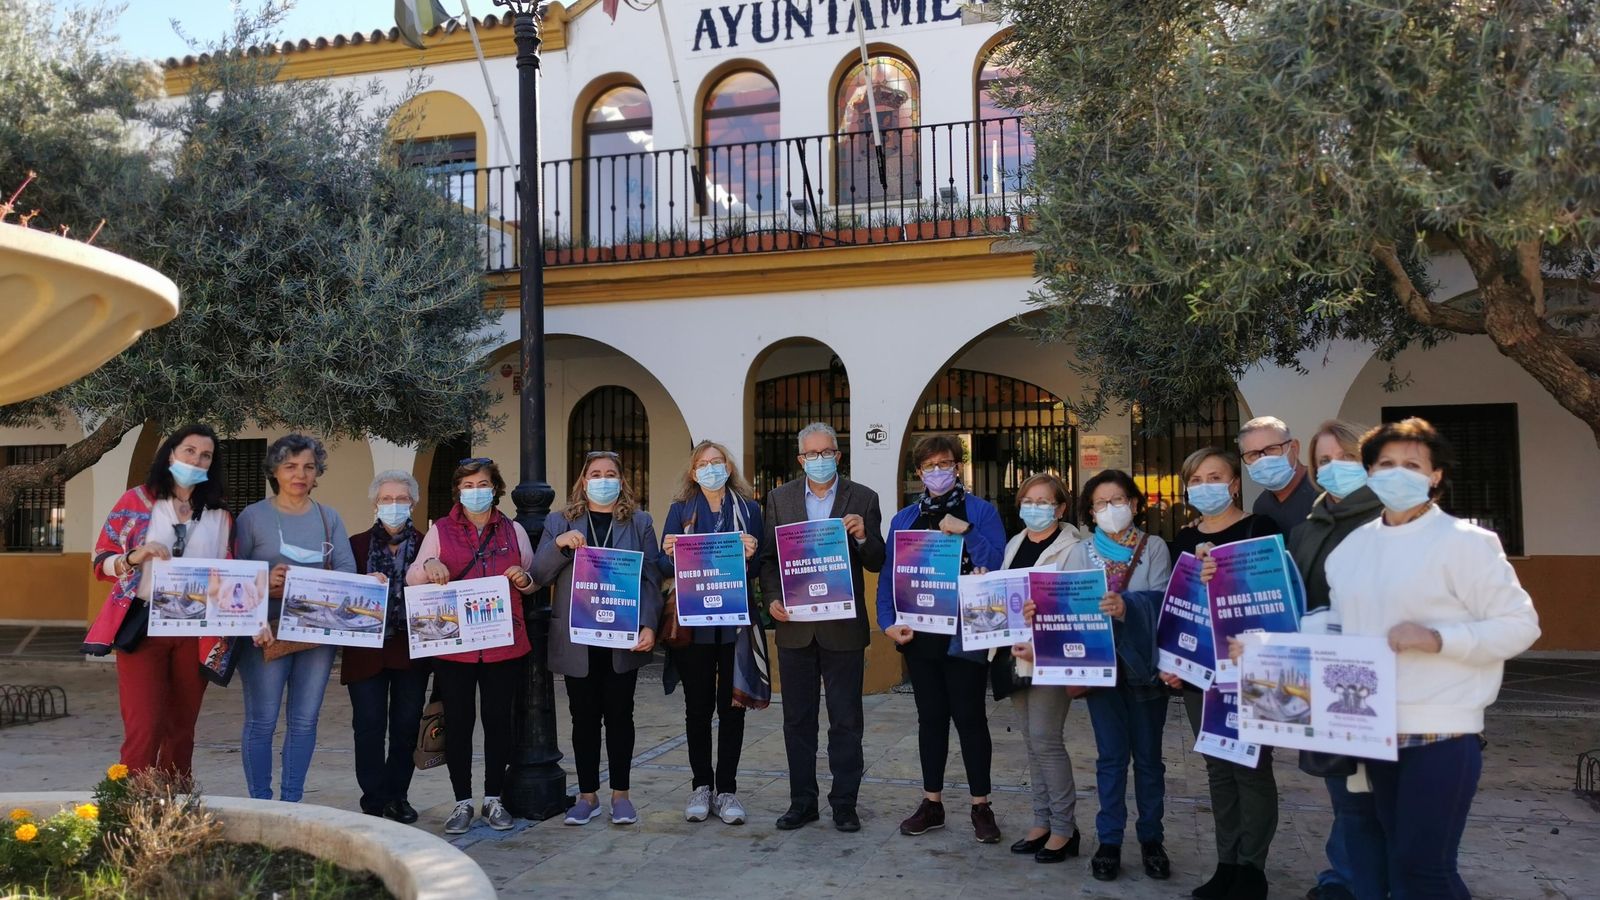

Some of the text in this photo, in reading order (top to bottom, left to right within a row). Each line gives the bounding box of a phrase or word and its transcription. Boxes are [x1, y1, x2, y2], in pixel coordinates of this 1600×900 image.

[692, 0, 989, 51] AYUNTAMIE
[792, 559, 811, 567] GOLPES
[679, 570, 701, 579] QUIERO
[791, 566, 817, 575] PALABRAS
[576, 581, 598, 590] QUIERO
[706, 581, 743, 590] SOBREVIVIR
[921, 580, 956, 590] SOBREVIVIR
[602, 597, 637, 607] SOBREVIVIR
[1216, 589, 1282, 607] NO HAGAS TRATOS
[1174, 596, 1191, 610] GOLPES
[1191, 601, 1201, 612] QUE
[1165, 604, 1170, 612] NI
[1170, 606, 1194, 622] PALABRAS
[1194, 614, 1204, 625] QUE
[1218, 608, 1232, 619] CON
[1234, 607, 1244, 618] EL
[1244, 602, 1285, 616] MALTRATO
[1185, 635, 1195, 645] 016
[1223, 694, 1231, 704] NO
